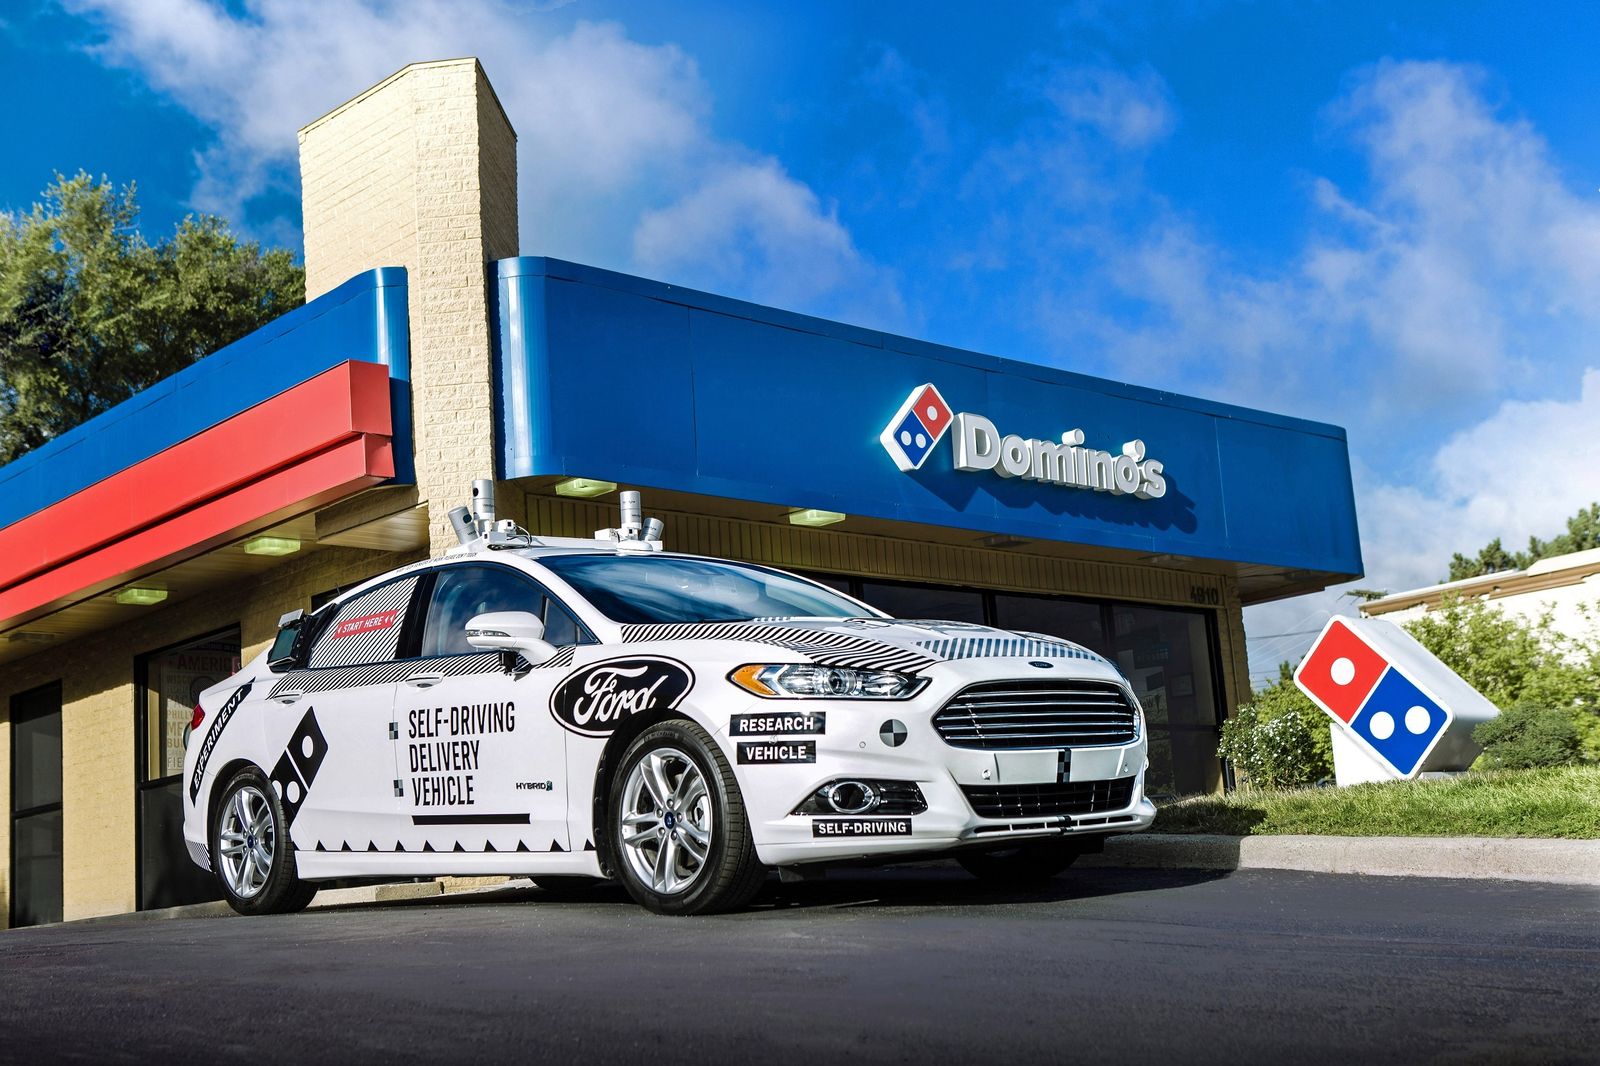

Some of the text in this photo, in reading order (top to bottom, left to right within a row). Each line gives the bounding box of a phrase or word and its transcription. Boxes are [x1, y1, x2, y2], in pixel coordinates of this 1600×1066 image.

[951, 411, 1166, 499] Domino's
[342, 616, 384, 633] START HERE
[573, 665, 669, 726] Ford
[408, 701, 516, 739] SELF-DRIVING
[739, 715, 814, 733] RESEARCH
[193, 688, 243, 790] EXPERIMENT
[745, 744, 807, 761] VEHICLE
[408, 740, 480, 773] DELIVERY
[411, 775, 475, 806] VEHICLE
[515, 782, 546, 790] HYBRID
[818, 820, 907, 835] SELF-DRIVING
